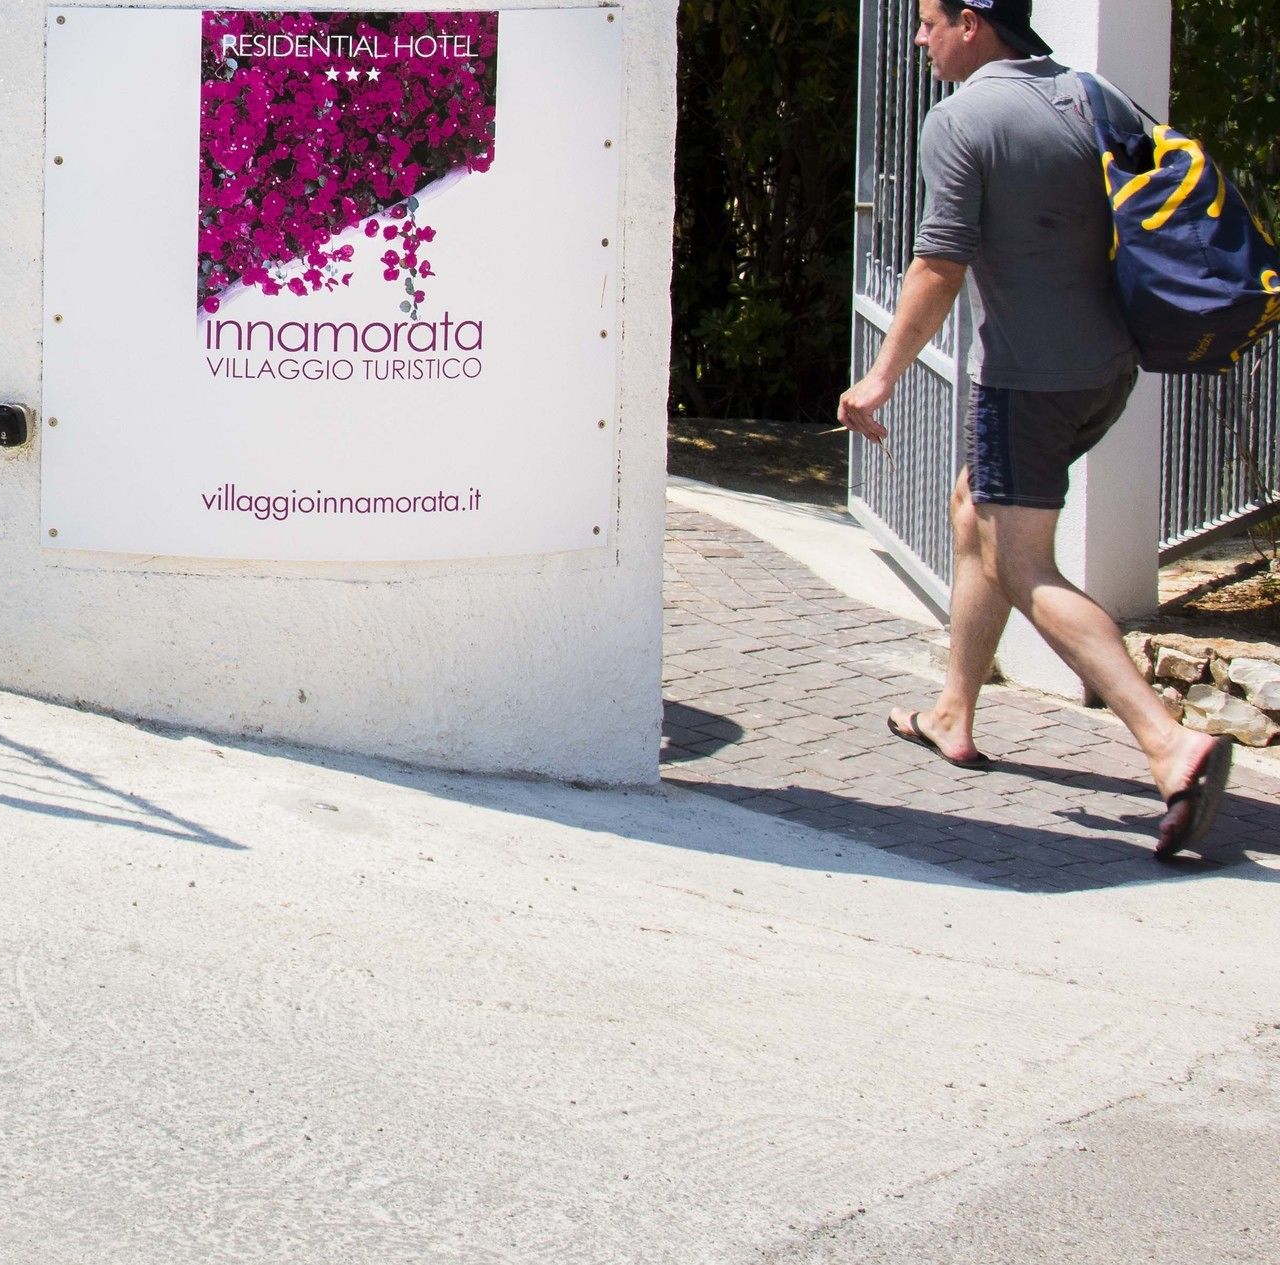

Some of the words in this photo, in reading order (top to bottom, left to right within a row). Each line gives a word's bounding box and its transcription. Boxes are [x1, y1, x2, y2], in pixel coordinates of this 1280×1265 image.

[222, 35, 390, 59] RESIDENTIAL
[394, 34, 479, 58] HOTEL
[205, 311, 483, 353] innamorata
[206, 356, 354, 381] VILLAGGIO
[362, 357, 482, 381] TURISTICO
[201, 483, 482, 521] villaggioinnamorata.it
